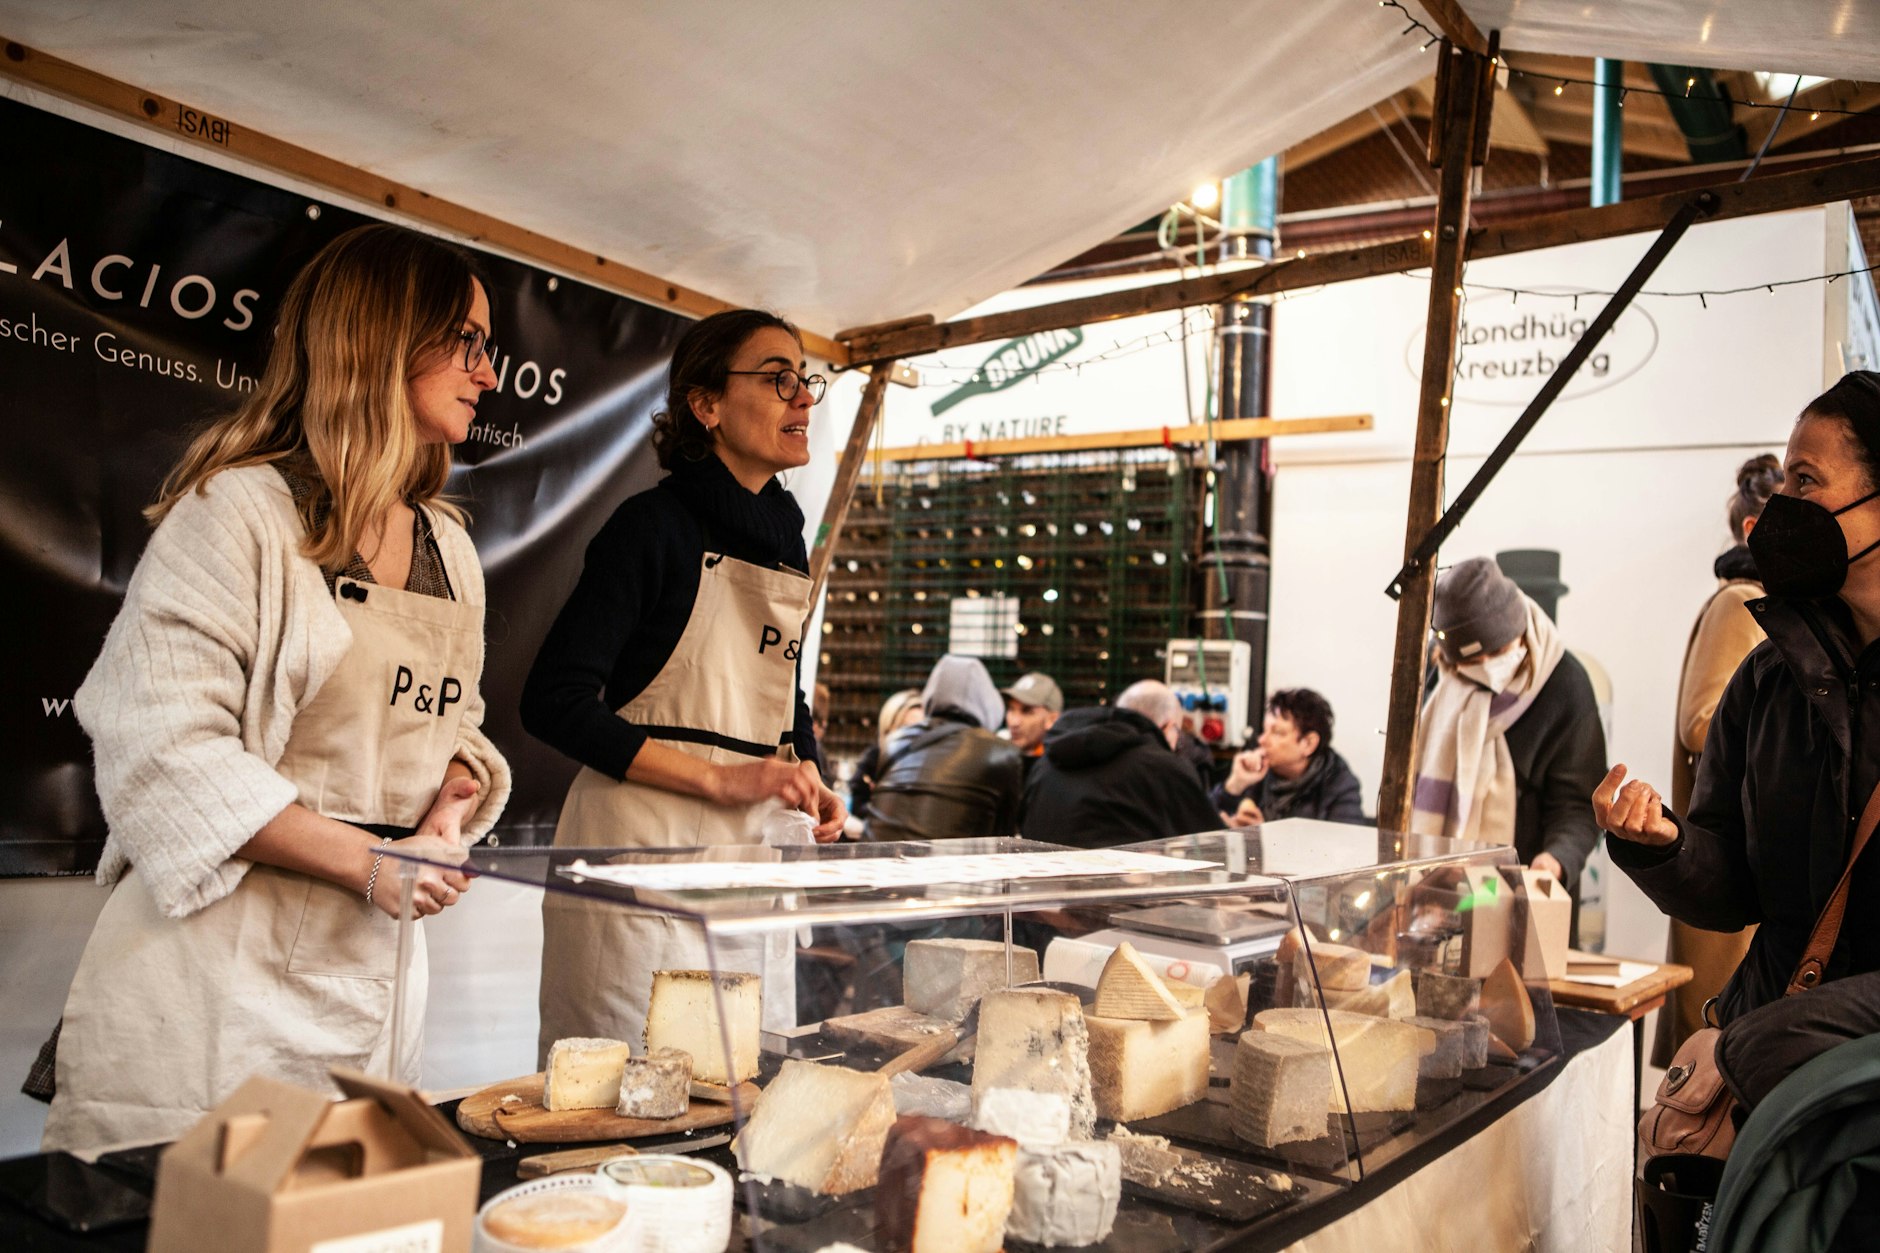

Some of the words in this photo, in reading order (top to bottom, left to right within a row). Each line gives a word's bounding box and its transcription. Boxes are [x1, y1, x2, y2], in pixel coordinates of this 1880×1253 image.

[1458, 313, 1615, 343] ondhüg
[490, 345, 566, 406] IOS
[983, 328, 1079, 390] DRUNK
[1458, 349, 1611, 378] reuzbg
[94, 332, 203, 383] Genuss.
[467, 422, 528, 450] ntisch.
[942, 423, 969, 444] BY
[979, 415, 1067, 441] NATURE
[389, 665, 462, 717] P&P
